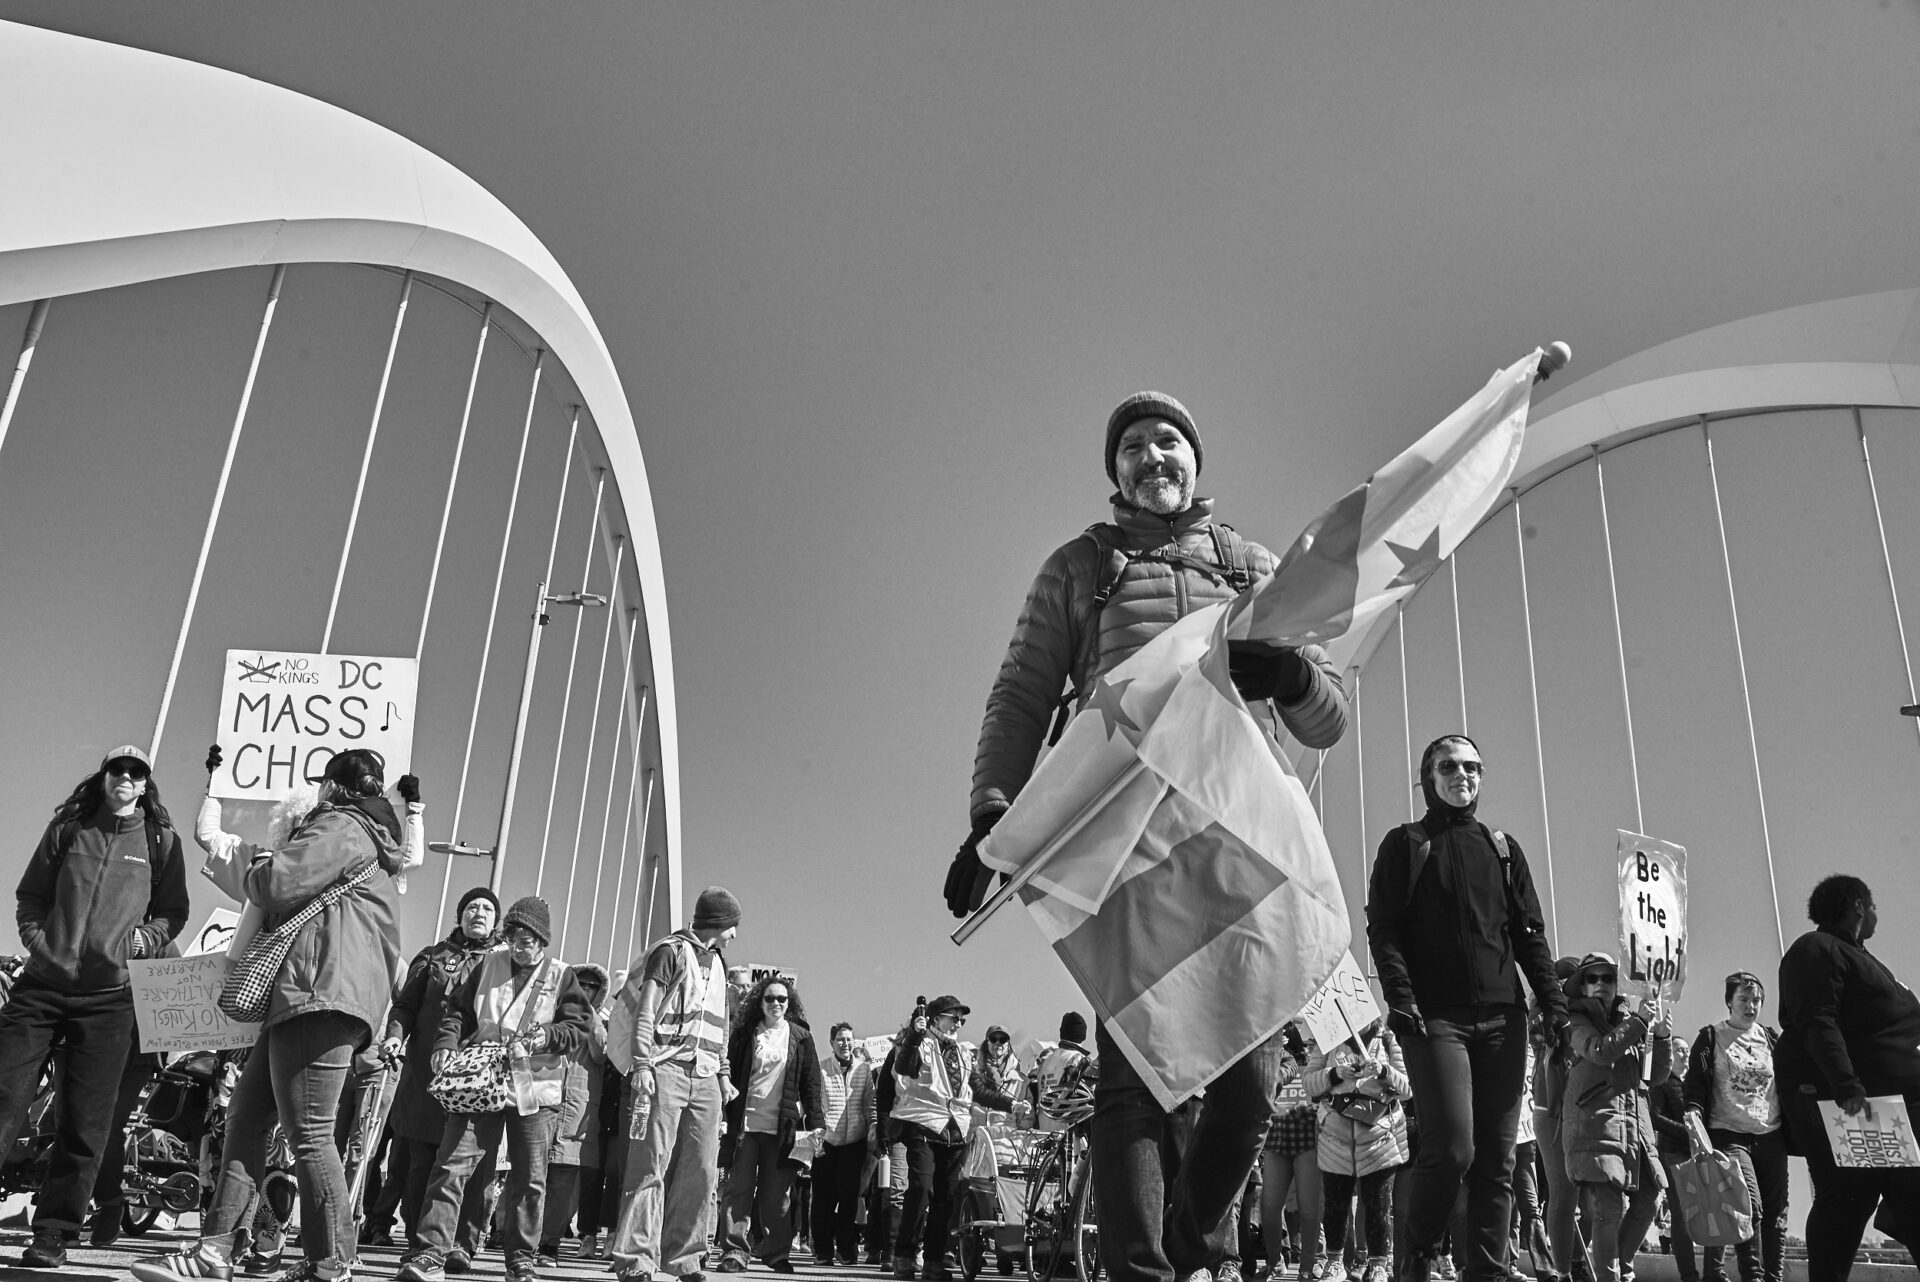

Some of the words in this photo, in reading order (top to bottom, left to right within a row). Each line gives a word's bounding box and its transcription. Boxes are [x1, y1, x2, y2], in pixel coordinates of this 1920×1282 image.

[284, 658, 309, 671] NO
[338, 659, 383, 690] DC
[278, 672, 320, 685] KINGS
[233, 692, 369, 740] MASS
[232, 743, 386, 790] CHO
[1636, 851, 1660, 883] Be
[1637, 891, 1667, 929] the
[146, 960, 217, 977] WARFARE
[751, 968, 770, 983] NO
[1630, 933, 1683, 999] Light
[139, 979, 226, 1002] EALTHCARE
[176, 974, 202, 985] NOT
[152, 1008, 198, 1032] KINGS!
[200, 1006, 230, 1031] NO
[1289, 1088, 1307, 1098] DC
[1880, 1130, 1902, 1159] THIS
